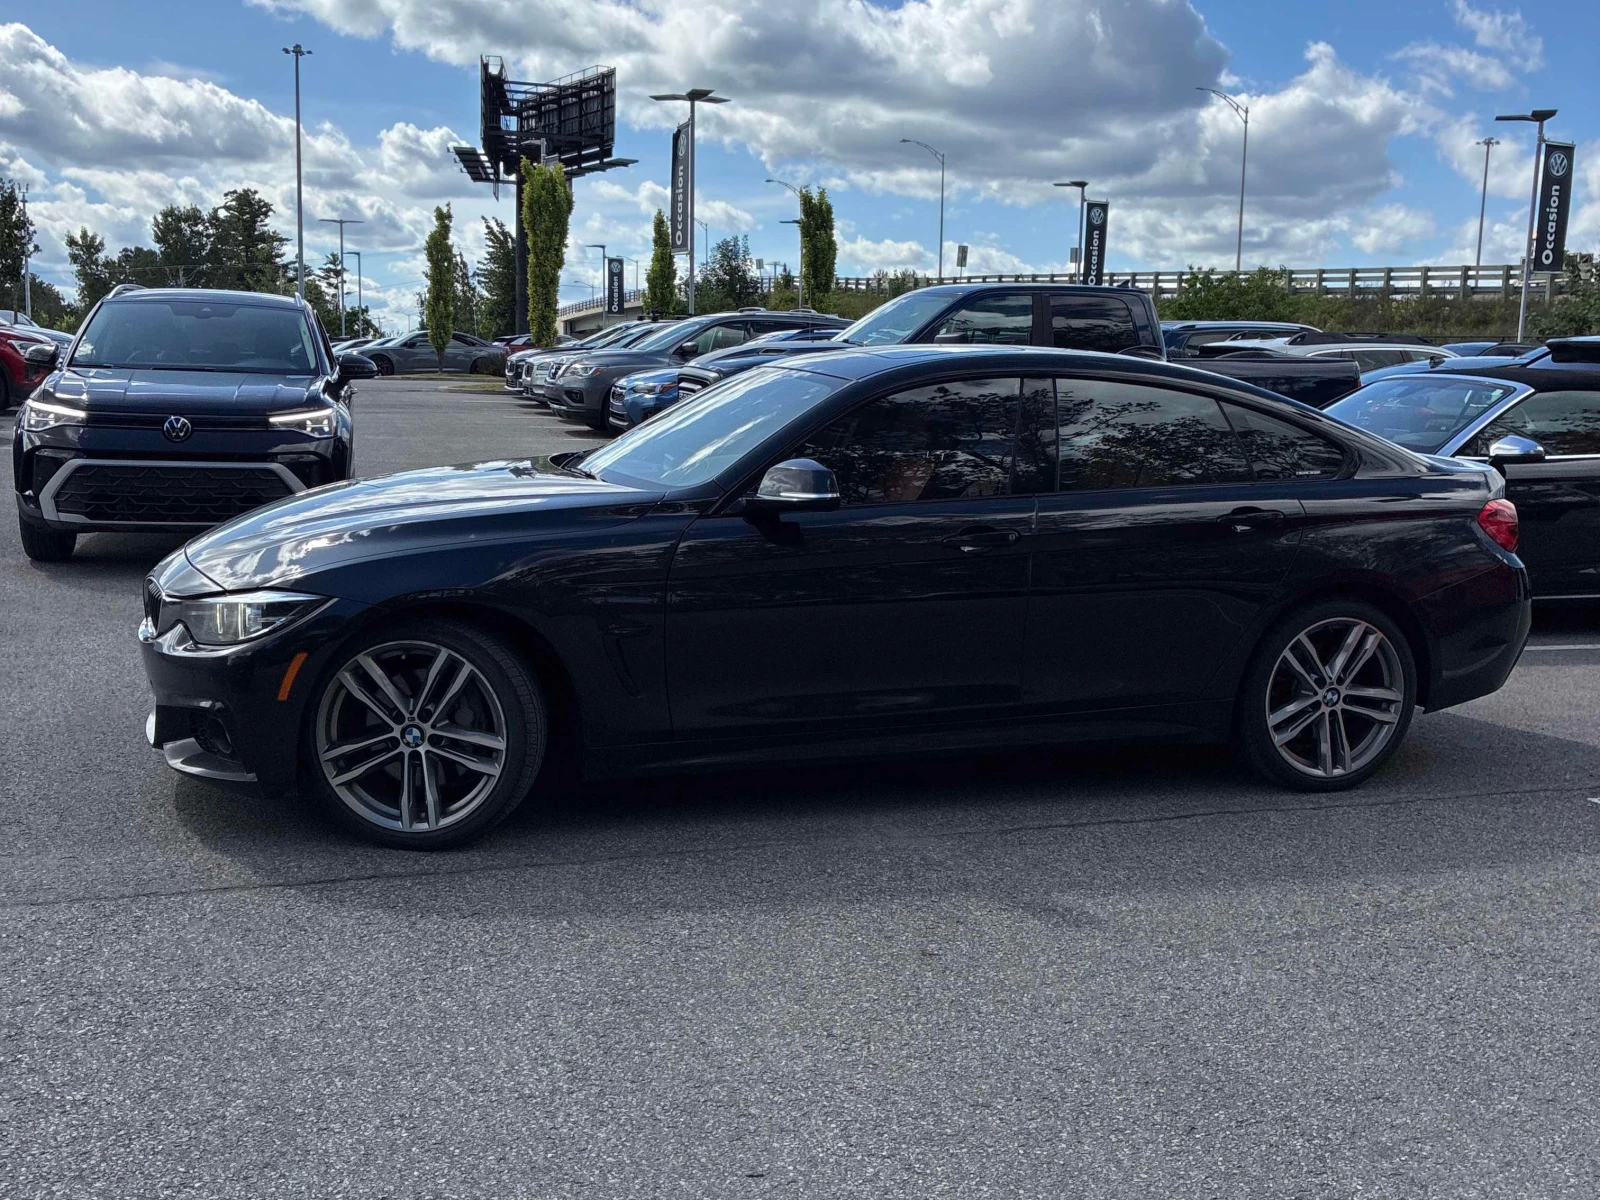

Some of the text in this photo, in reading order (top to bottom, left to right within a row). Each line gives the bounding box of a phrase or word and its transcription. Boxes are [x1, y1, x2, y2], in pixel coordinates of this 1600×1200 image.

[675, 165, 684, 246] Occasion
[1541, 185, 1561, 265] Occasion
[1087, 230, 1100, 286] Occasion
[611, 276, 619, 312] Occasion
